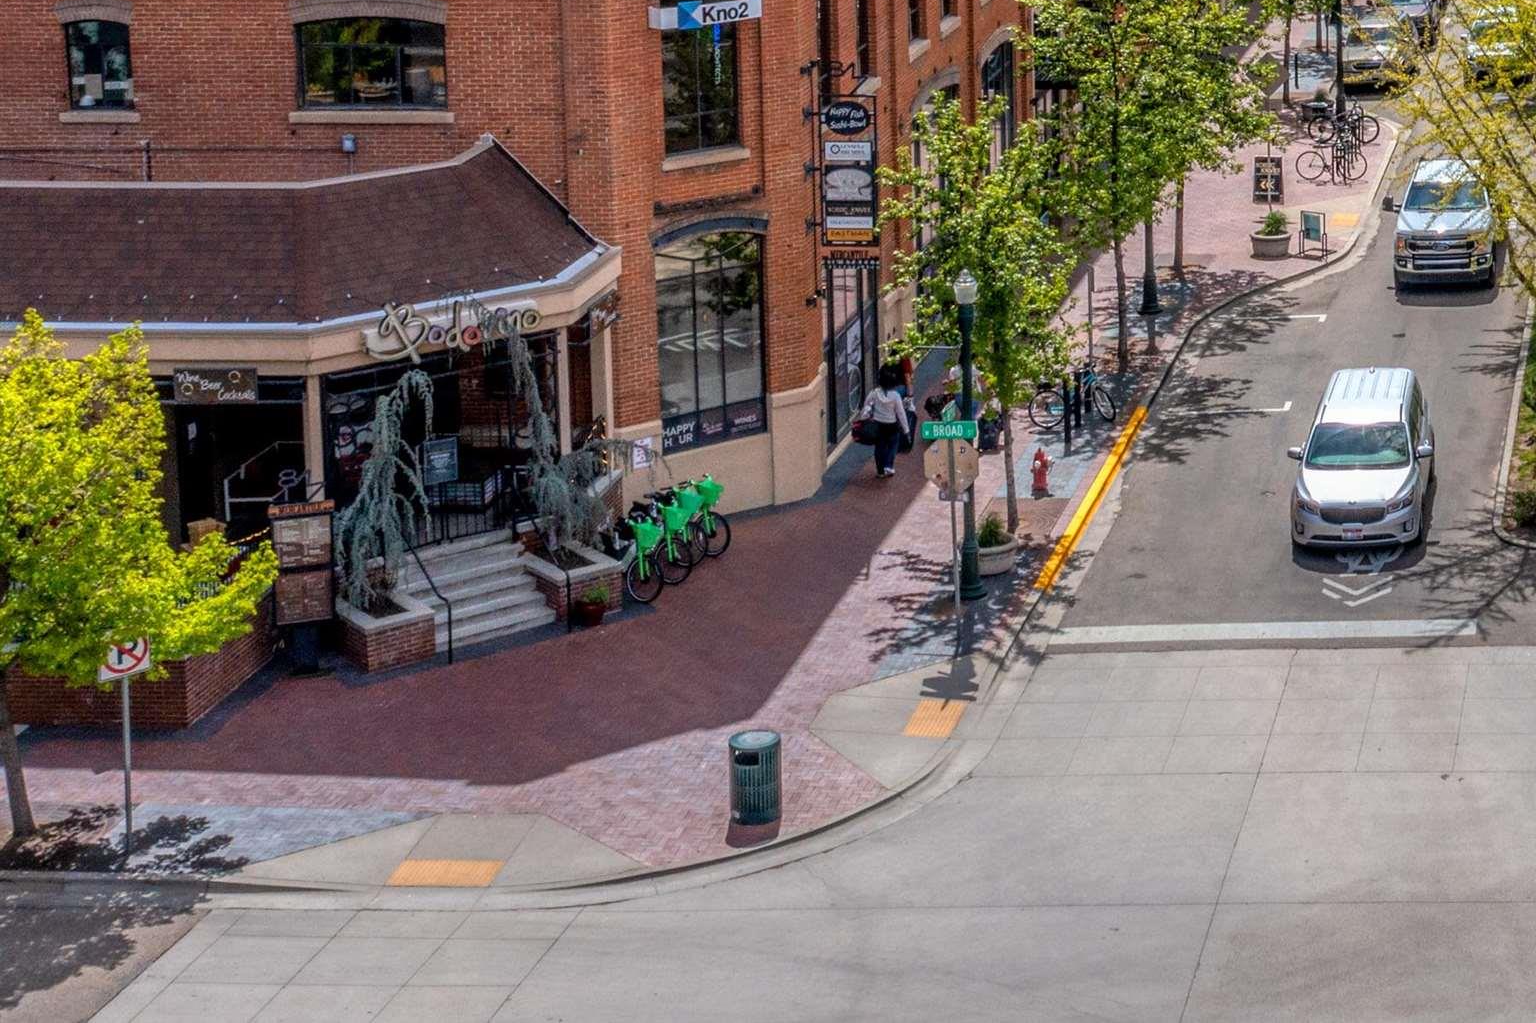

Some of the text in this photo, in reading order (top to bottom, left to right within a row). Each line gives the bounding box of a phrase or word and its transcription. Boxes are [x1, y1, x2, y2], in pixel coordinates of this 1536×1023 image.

[702, 2, 749, 23] Kno2
[366, 302, 542, 365] Bodoino
[217, 387, 256, 401] Cocktails
[662, 421, 695, 437] HAPPY
[932, 424, 963, 437] BROAD
[664, 434, 693, 448] HUR
